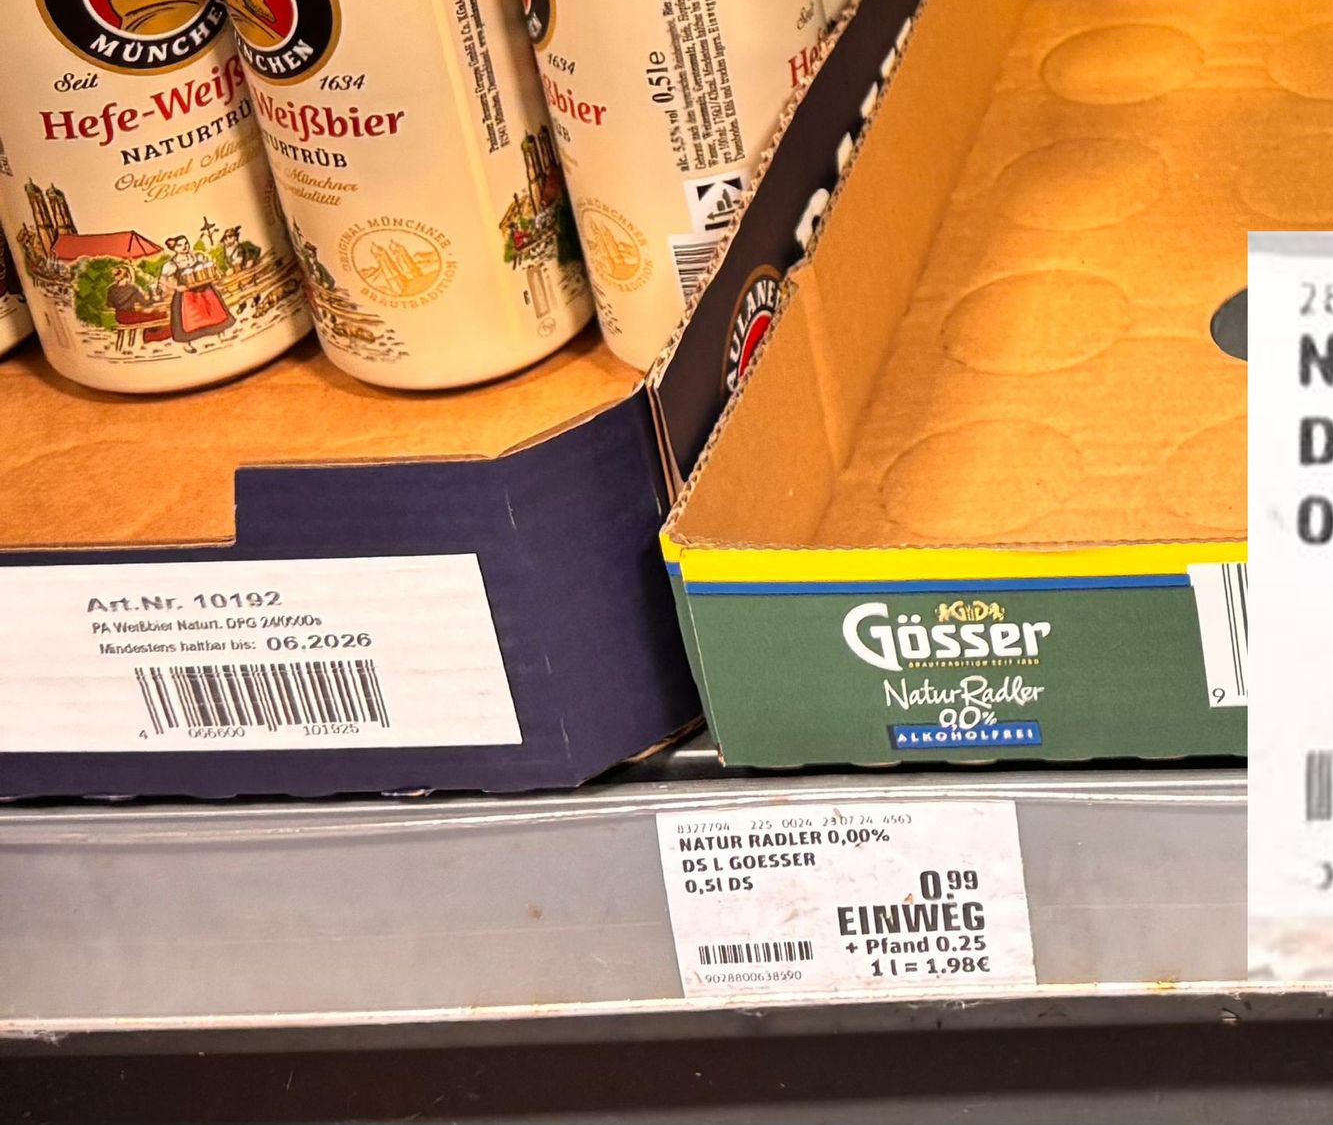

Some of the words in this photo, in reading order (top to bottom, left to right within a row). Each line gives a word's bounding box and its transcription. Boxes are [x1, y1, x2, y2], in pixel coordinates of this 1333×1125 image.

[54, 73, 99, 92] Seit
[319, 74, 366, 91] 1634
[40, 57, 248, 147] Hefe-Weiß
[88, 597, 183, 612] Art.Nr.
[194, 591, 282, 609] 10192
[231, 639, 257, 651] bis:
[266, 633, 372, 651] 06.2026
[843, 602, 1051, 672] Gösser
[897, 727, 1035, 745] ALKOHOLFREI
[751, 820, 772, 830] 225
[782, 819, 812, 828] 0024
[679, 835, 743, 852] NATUR
[749, 831, 821, 847] RADLER
[828, 829, 890, 846] 0,00%
[682, 859, 707, 873] DS
[714, 858, 723, 871] L
[730, 852, 816, 870] GOESSER
[729, 876, 753, 891] DS
[920, 870, 979, 900] 0.99
[838, 902, 984, 935] EINWEG
[846, 943, 858, 953] +
[867, 937, 929, 954] Pfand
[936, 936, 986, 952] 0.25
[871, 961, 883, 976] 1
[905, 963, 918, 972] =
[927, 956, 990, 974] 1.98€
